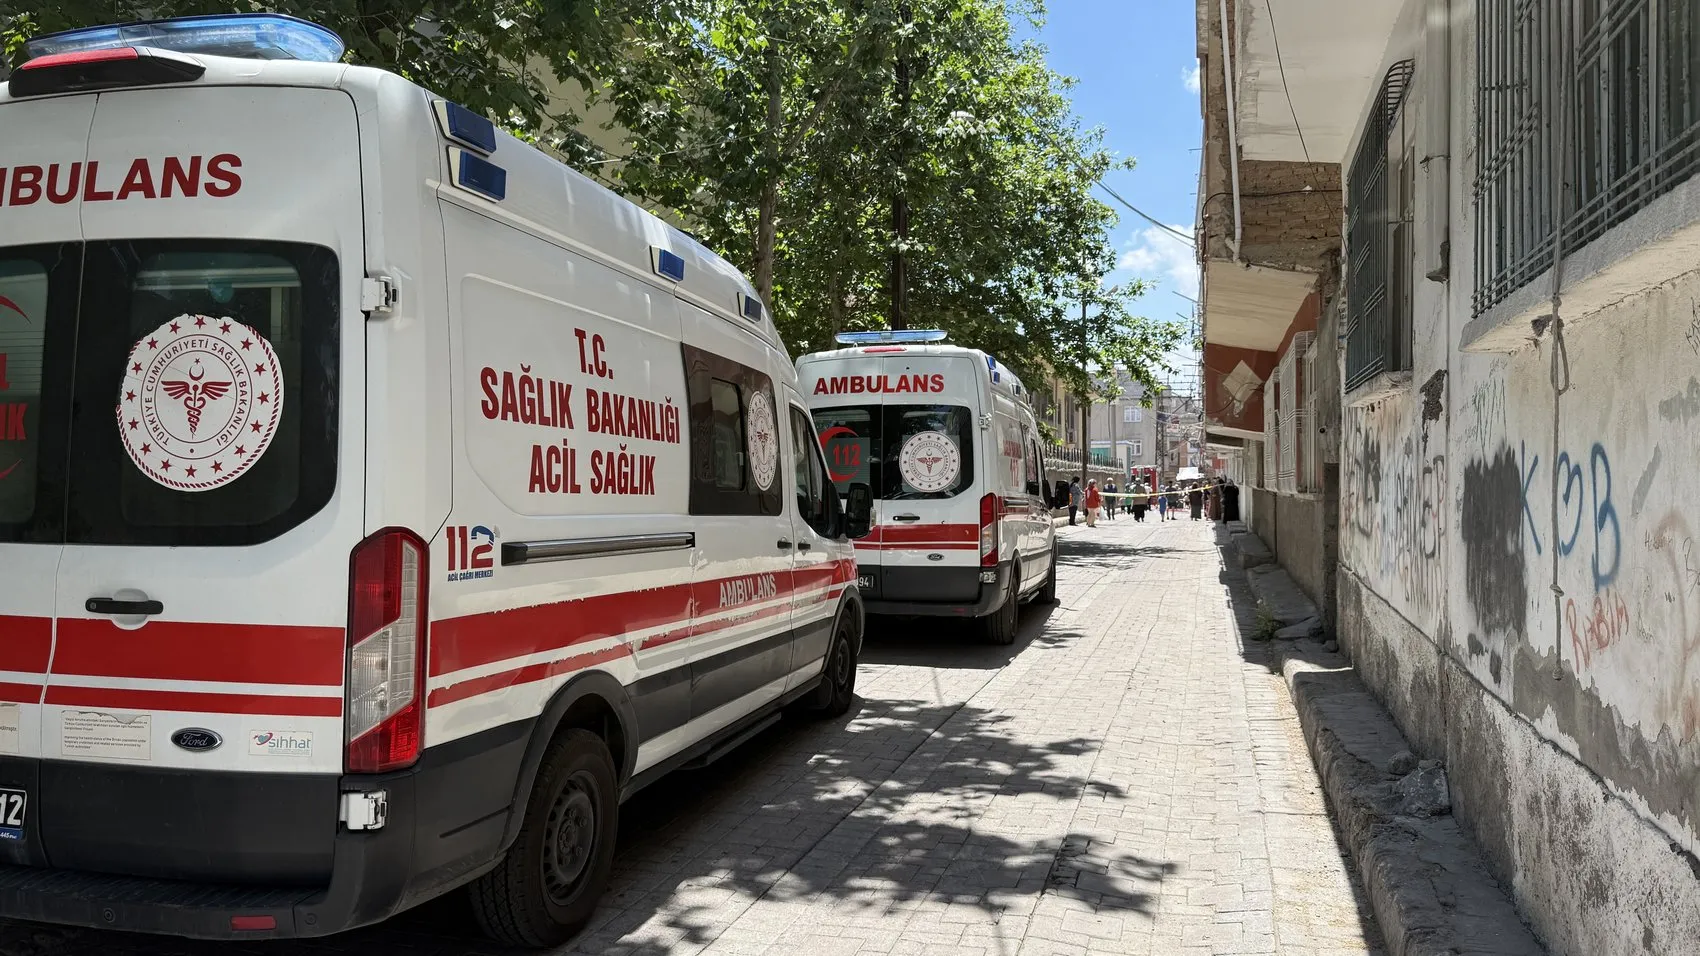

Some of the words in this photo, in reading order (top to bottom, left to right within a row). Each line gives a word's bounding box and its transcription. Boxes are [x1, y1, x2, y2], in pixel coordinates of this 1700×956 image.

[0, 153, 243, 208] BULANS
[146, 338, 209, 393] CUMHURİYETİ
[211, 342, 245, 378] SAĞLIK
[574, 327, 614, 380] T.C.
[480, 363, 575, 430] SAĞLIK
[586, 388, 681, 445] BAKANLIĞI
[813, 374, 945, 396] AMBULANS
[145, 397, 171, 446] TÜRKİYE
[216, 380, 248, 446] BAKANLIĞI
[528, 438, 582, 494] ACİL
[590, 443, 657, 496] SAĞLIK
[833, 444, 861, 467] 112
[1591, 442, 1622, 594] B
[446, 525, 495, 571] 112
[719, 573, 777, 608] AMBULANS
[179, 731, 209, 747] Ford
